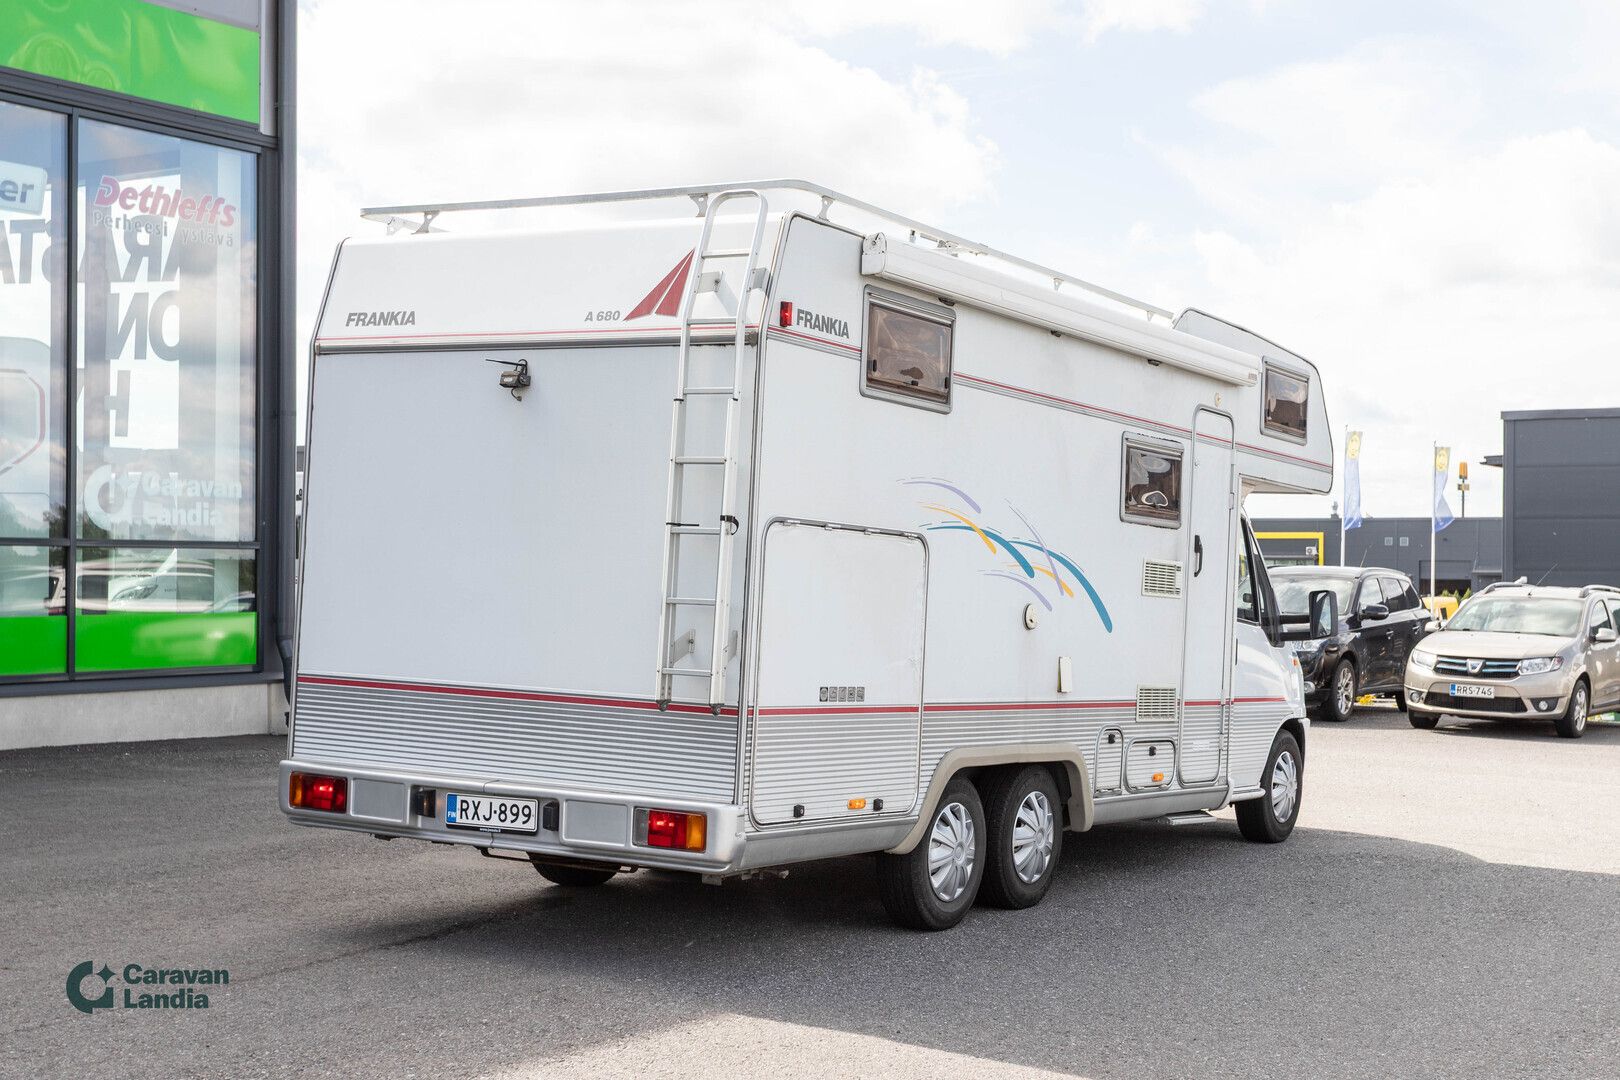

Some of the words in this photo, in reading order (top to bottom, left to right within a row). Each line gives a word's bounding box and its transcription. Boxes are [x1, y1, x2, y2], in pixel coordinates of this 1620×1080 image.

[95, 176, 237, 228] Dethleffs
[93, 210, 168, 237] Perheesi
[182, 228, 234, 247] ystävä
[345, 311, 416, 327] FRANKIA
[584, 311, 593, 322] A
[596, 310, 621, 321] 680
[796, 308, 850, 339] FRANKIA
[459, 799, 532, 825] RXJ-899
